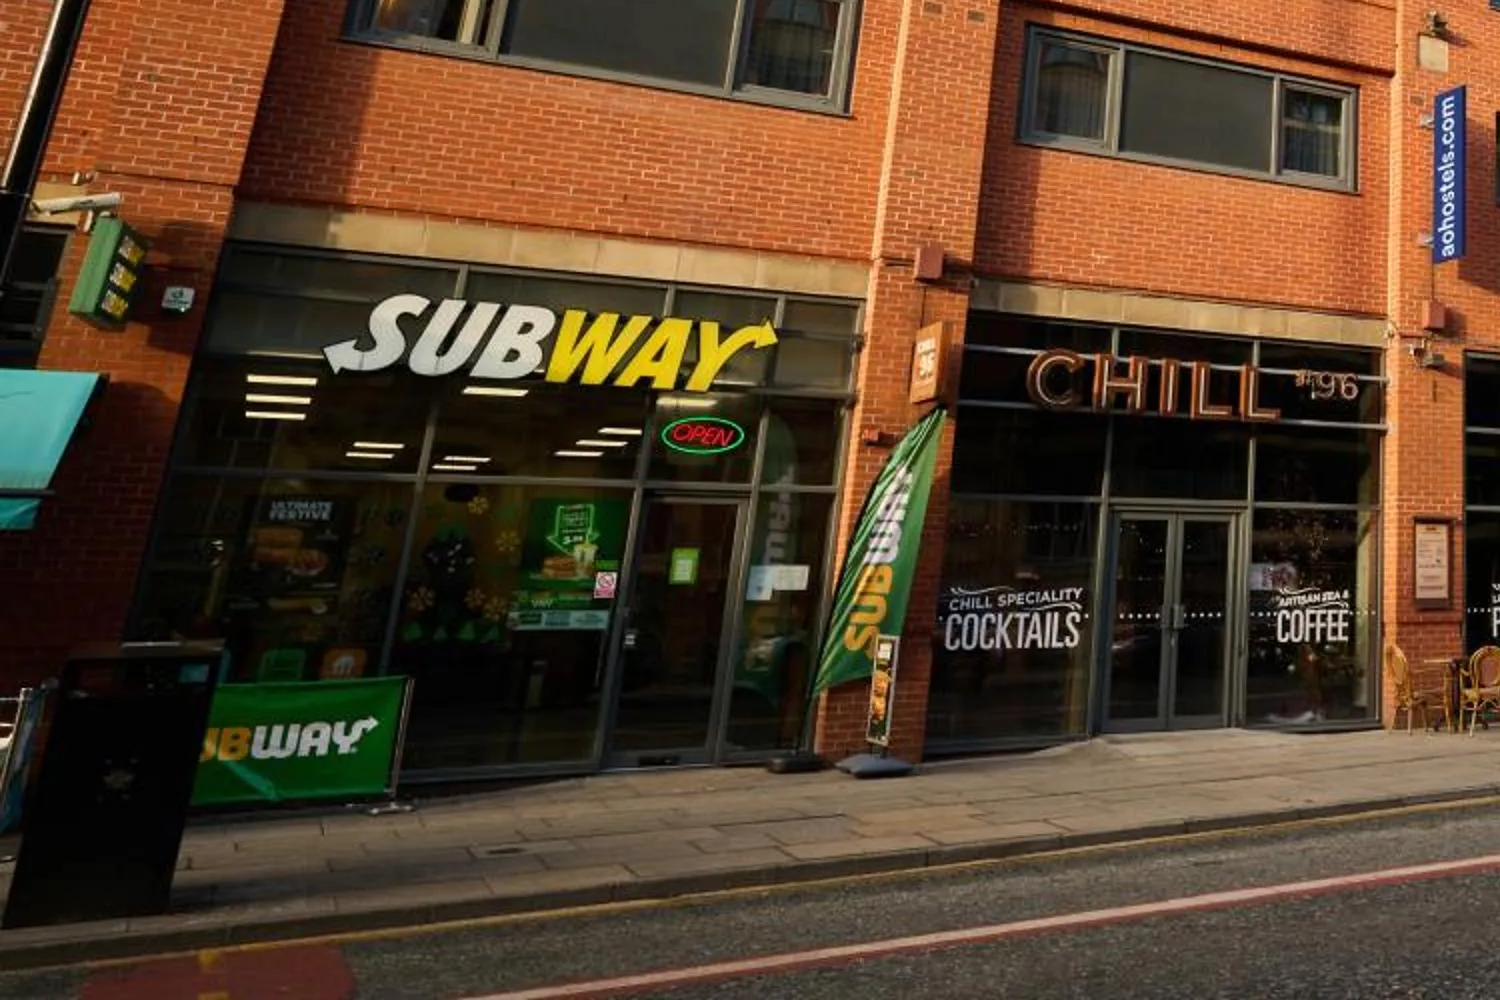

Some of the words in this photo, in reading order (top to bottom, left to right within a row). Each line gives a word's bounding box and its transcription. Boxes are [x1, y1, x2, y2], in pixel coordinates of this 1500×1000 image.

[1438, 96, 1455, 257] aohostels.com
[324, 294, 778, 392] SUBWAY
[1026, 349, 1281, 422] CHILL
[672, 423, 735, 446] OPEN
[949, 596, 992, 611] CHILL
[998, 587, 1083, 607] SPECIALITY
[945, 611, 1081, 650] COCKTAILS
[1277, 609, 1349, 643] COFFEE
